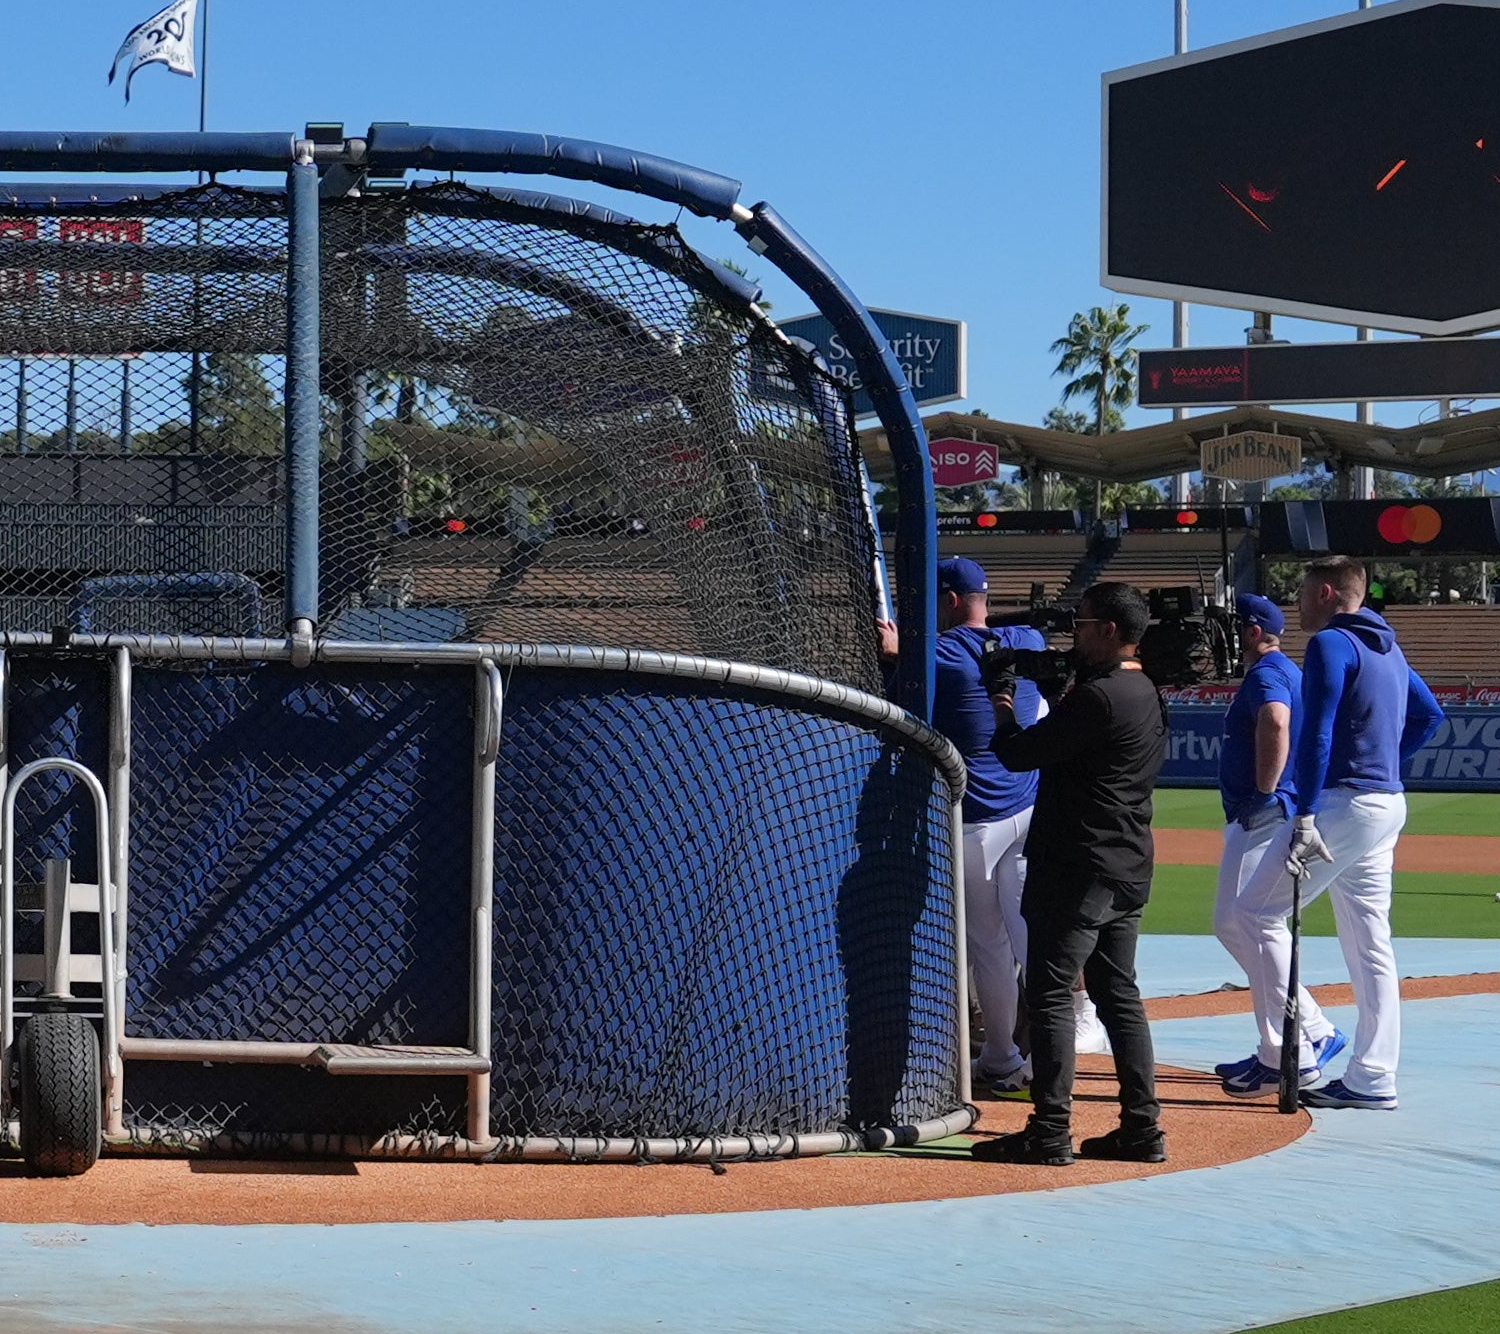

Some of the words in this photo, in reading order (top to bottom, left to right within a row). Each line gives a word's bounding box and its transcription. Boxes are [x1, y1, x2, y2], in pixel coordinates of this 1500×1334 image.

[829, 332, 942, 364] Srity
[930, 452, 970, 466] ISO
[1207, 443, 1241, 473] JIM
[1243, 436, 1294, 471] BEAM
[1203, 692, 1212, 701] A
[1213, 692, 1228, 701] HIT
